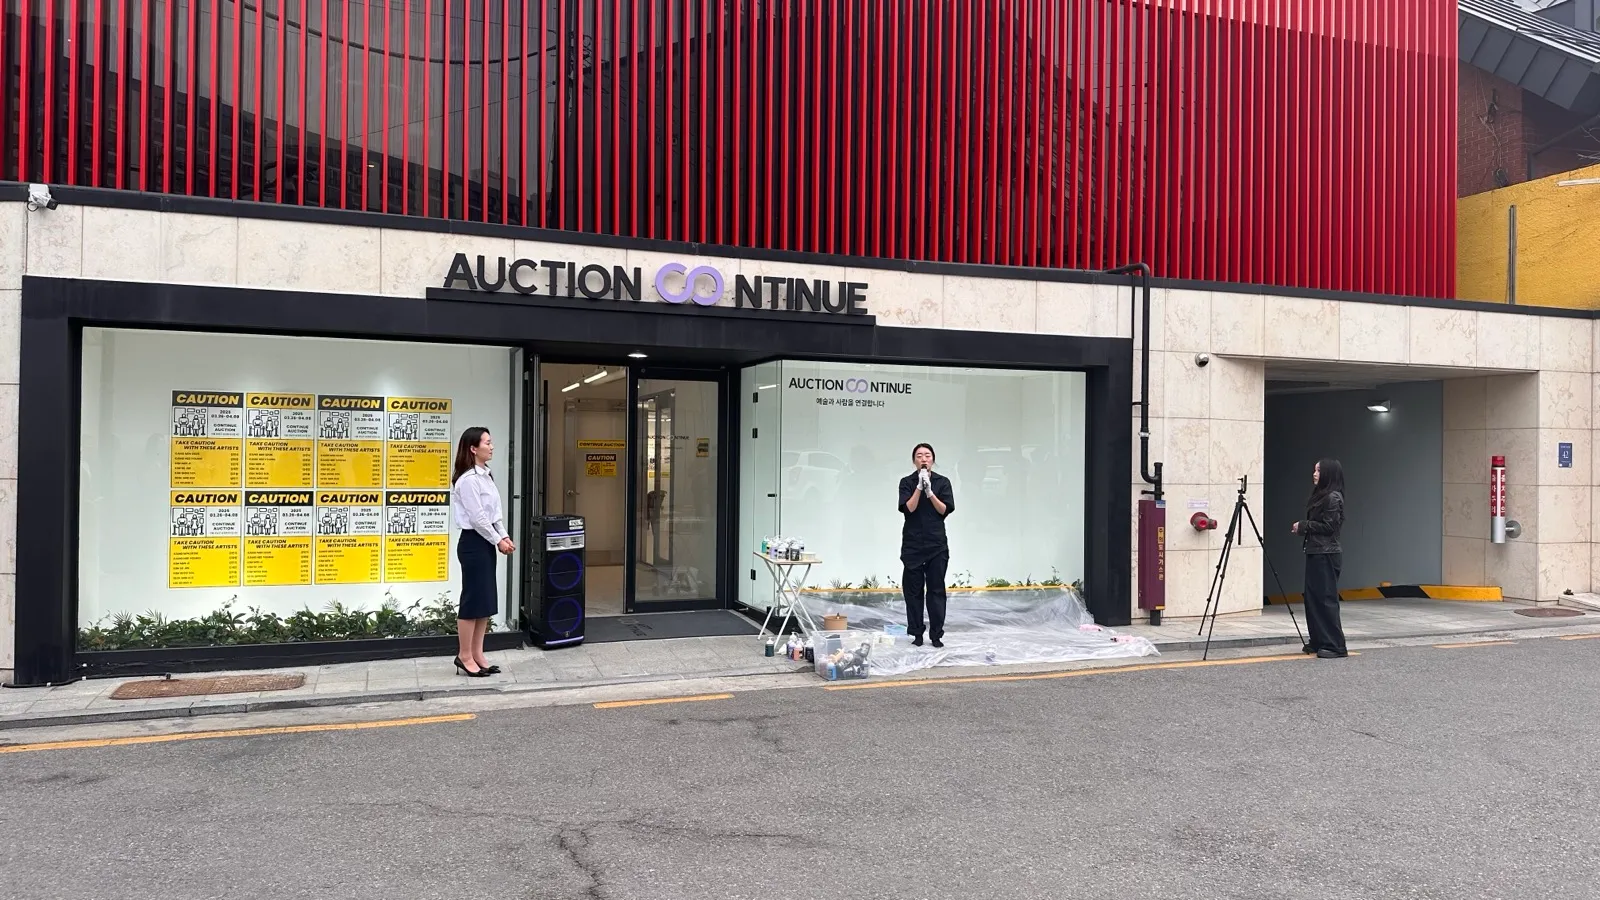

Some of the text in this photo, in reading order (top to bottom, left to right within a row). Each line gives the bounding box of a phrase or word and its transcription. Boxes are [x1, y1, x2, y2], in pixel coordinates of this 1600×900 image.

[443, 253, 642, 300] AUCTION
[788, 377, 844, 391] AUCTION
[176, 394, 240, 405] CAUTION
[250, 396, 311, 406] CAUTION
[321, 398, 380, 408] CAUTION
[816, 397, 885, 408] 예술과 사람을 연결합니다
[390, 400, 448, 411] CAUTION
[1562, 450, 1569, 459] 42
[175, 493, 237, 503] CAUTION
[248, 494, 309, 503] CAUTION
[319, 494, 379, 503] CAUTION
[389, 494, 446, 503] CAUTION
